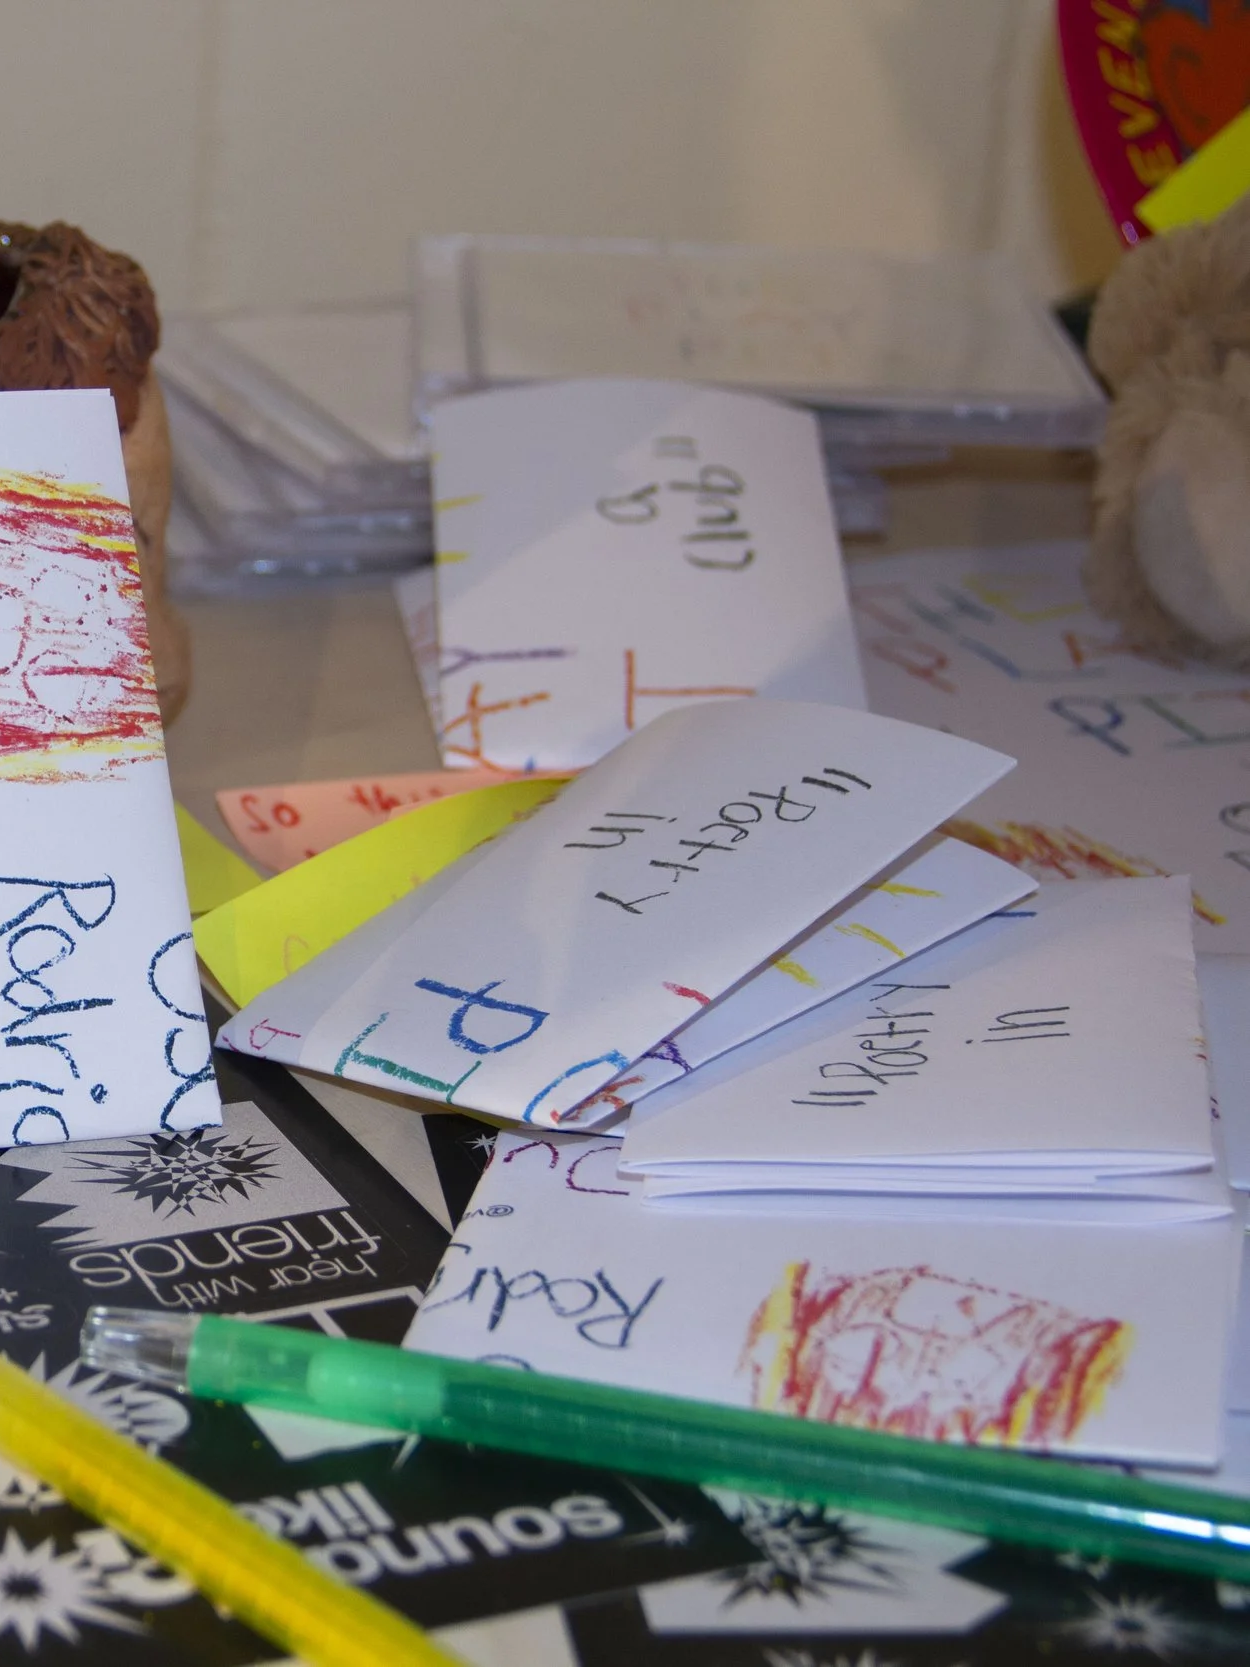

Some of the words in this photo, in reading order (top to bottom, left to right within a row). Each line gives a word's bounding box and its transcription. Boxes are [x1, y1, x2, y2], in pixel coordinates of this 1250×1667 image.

[69, 1211, 381, 1290] friends
[268, 1254, 377, 1291] hear
[152, 1275, 256, 1310] with
[422, 1266, 664, 1350] Rodr
